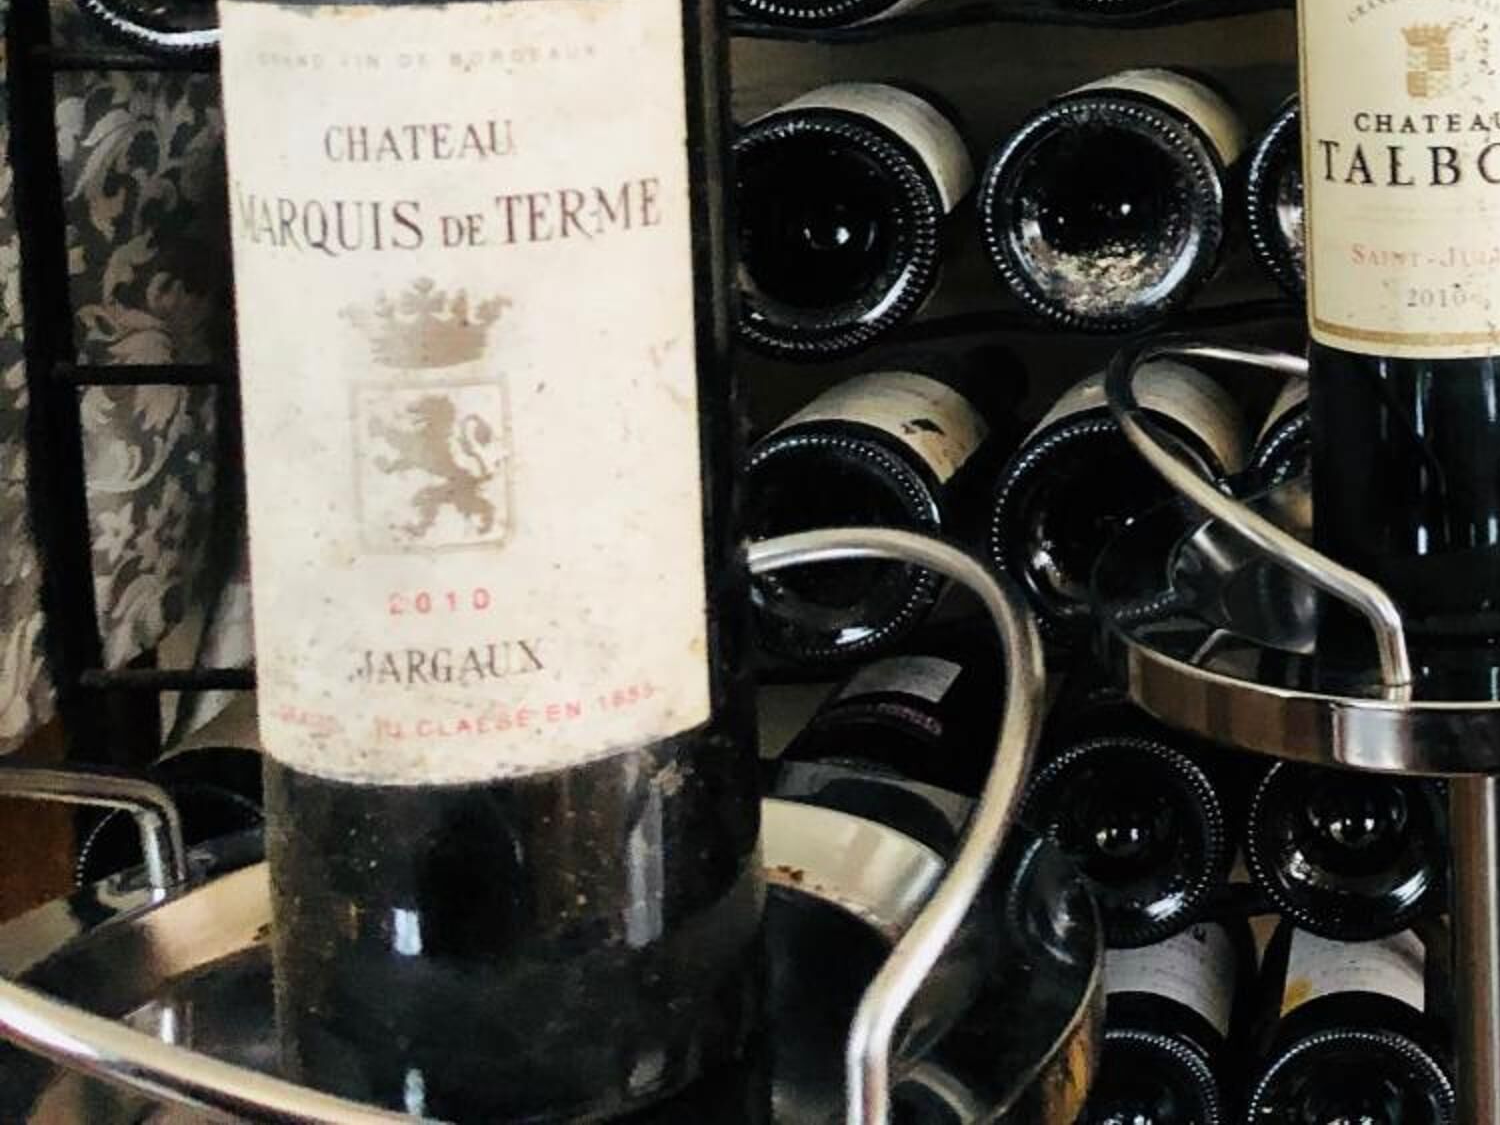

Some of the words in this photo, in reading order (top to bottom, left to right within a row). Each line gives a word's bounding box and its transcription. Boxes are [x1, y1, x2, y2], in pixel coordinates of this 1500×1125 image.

[323, 119, 514, 162] CHATEAU
[441, 213, 482, 247] DE
[495, 177, 662, 243] TERME
[1407, 286, 1468, 308] 2010
[388, 587, 493, 617] 2010
[545, 700, 583, 724] EN
